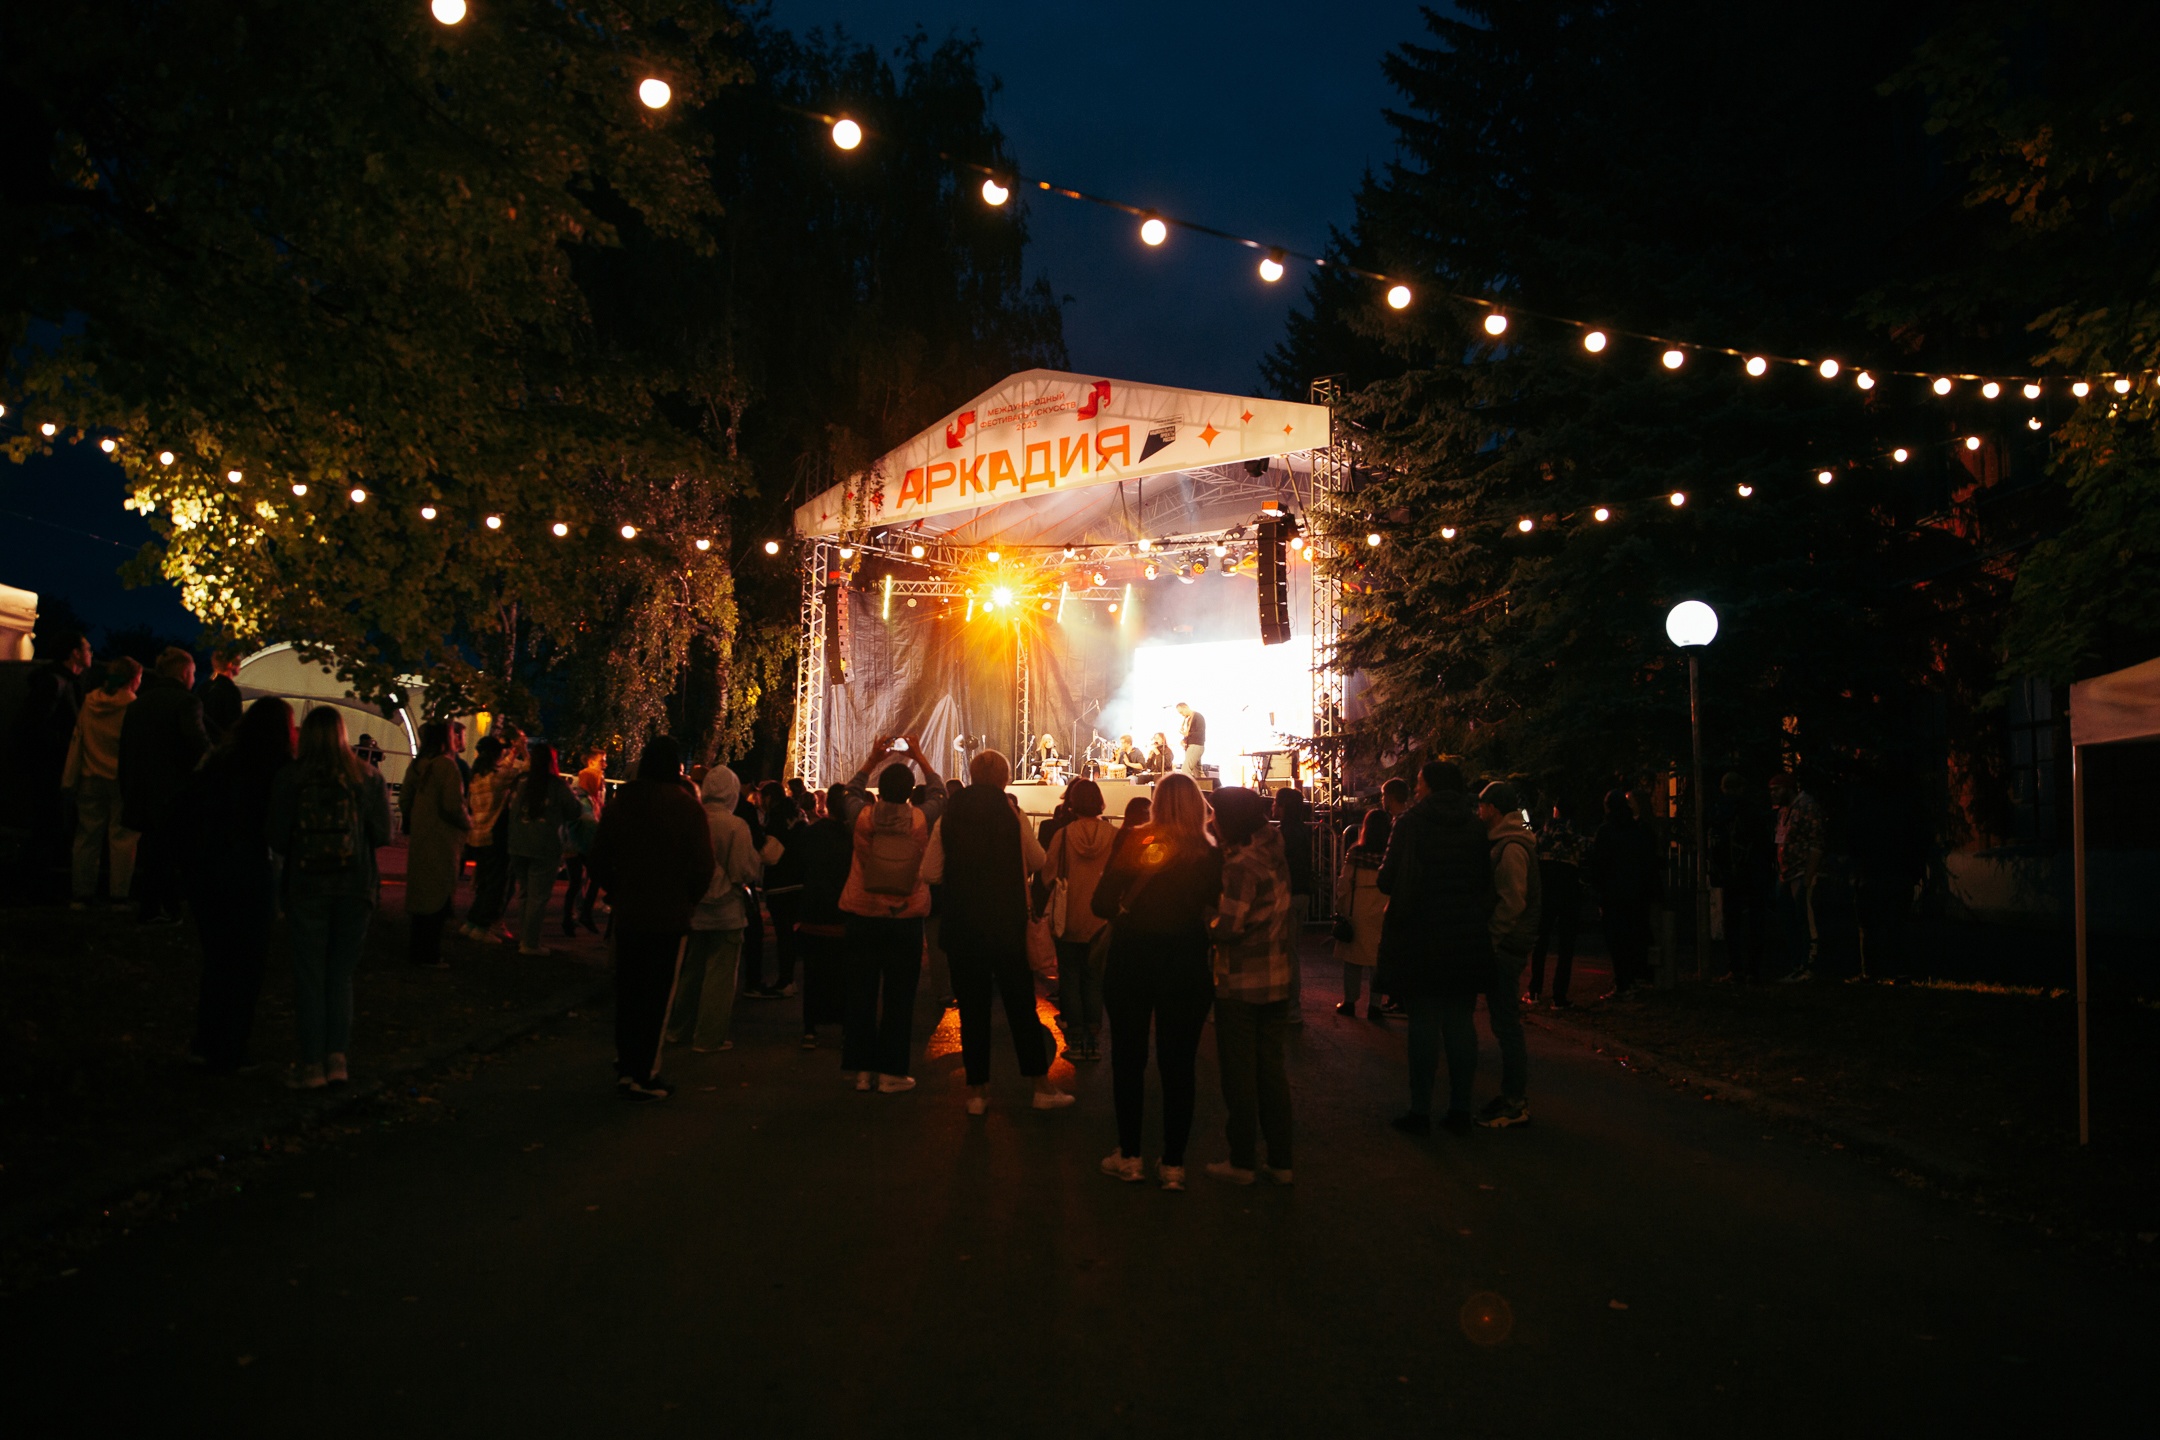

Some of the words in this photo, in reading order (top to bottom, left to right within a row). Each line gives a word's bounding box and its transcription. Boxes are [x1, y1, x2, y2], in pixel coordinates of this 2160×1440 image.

[980, 411, 1029, 428] ФЕСТИВАЛЬ
[1030, 401, 1077, 417] ИСКУССТВ
[987, 392, 1065, 416] МЕЖДУНАРОДНЫЙ
[1016, 420, 1038, 431] 2023
[896, 425, 1130, 508] АРКАДИЯ
